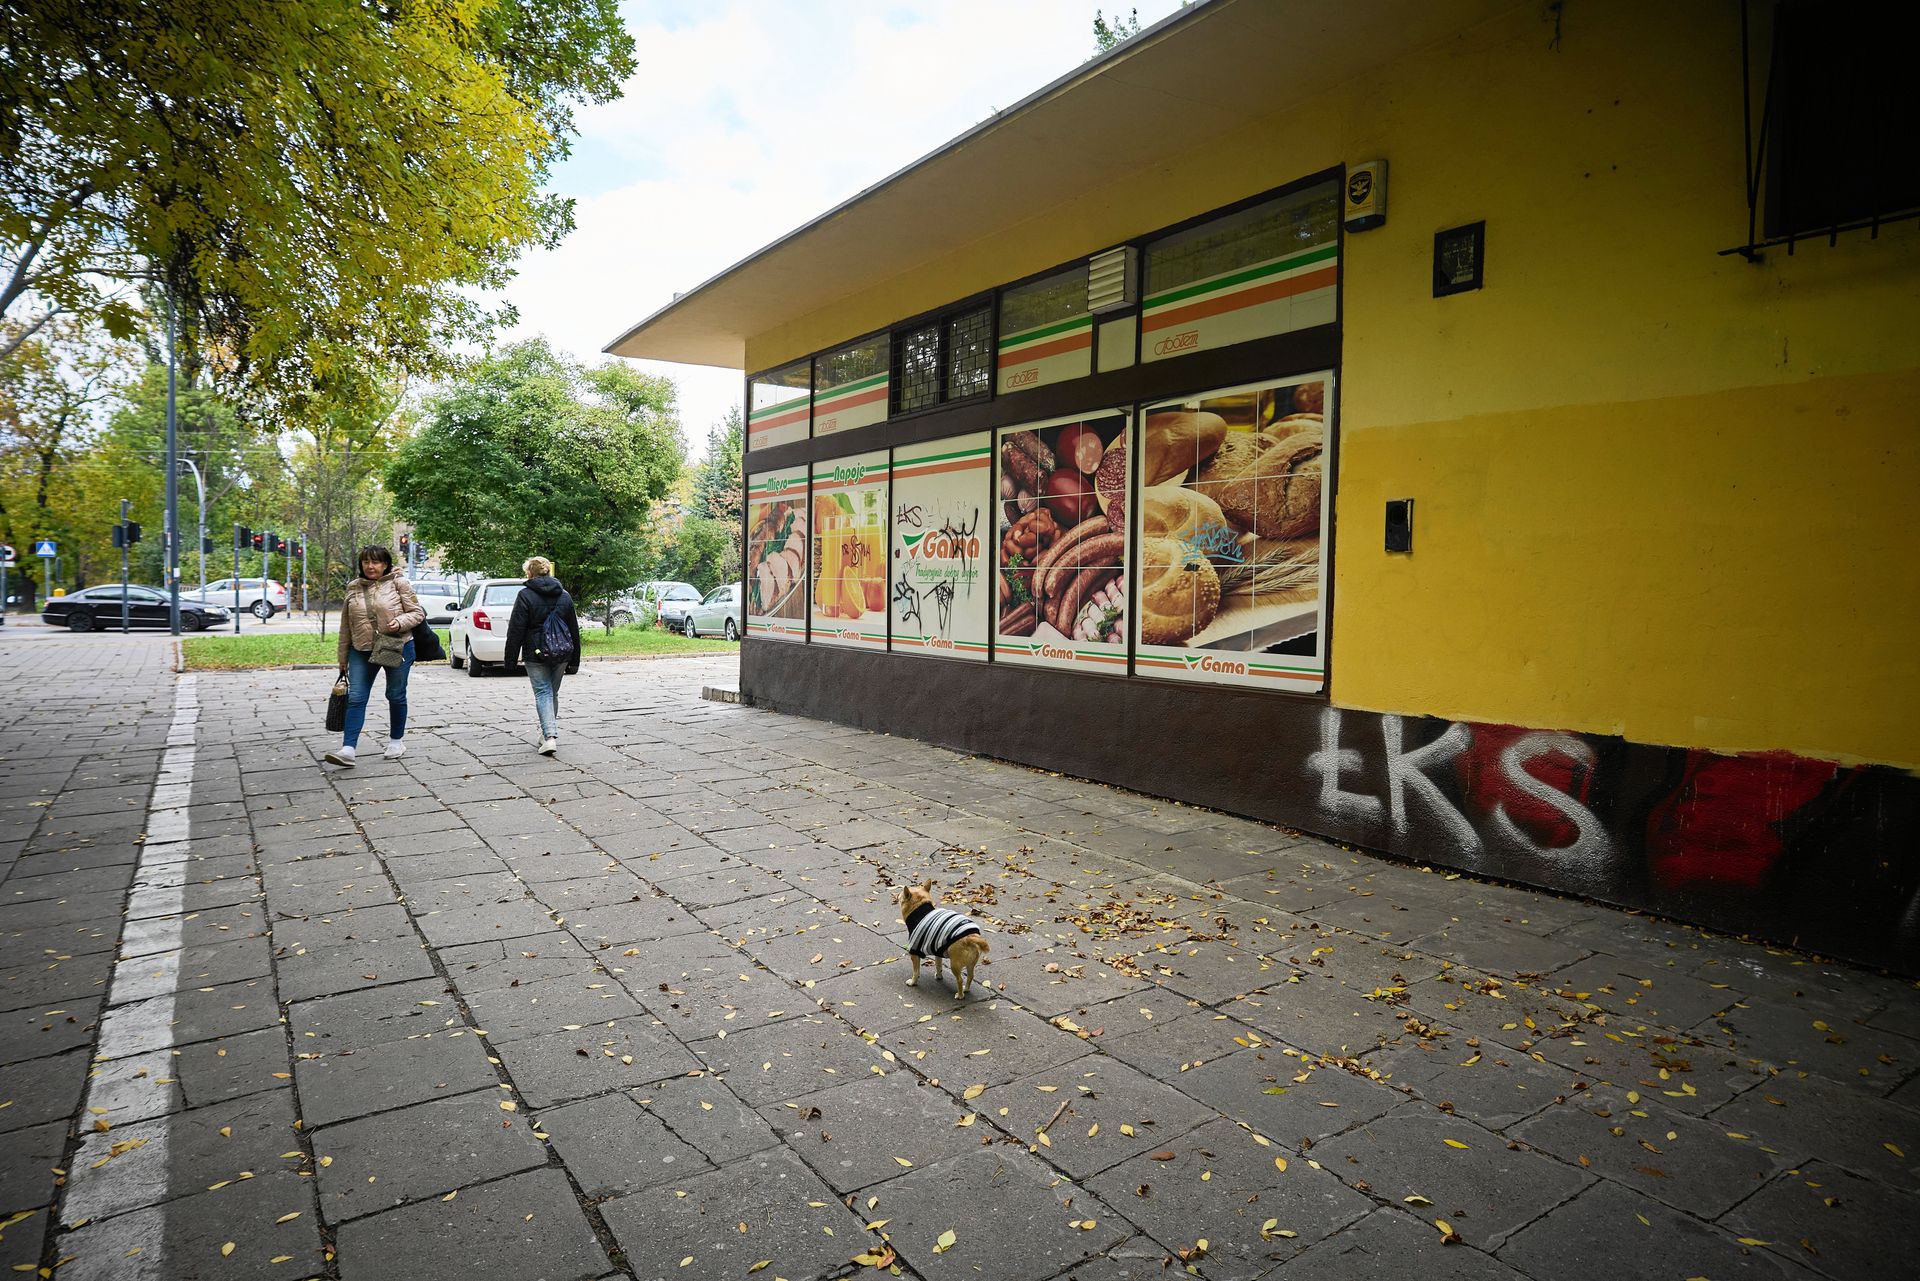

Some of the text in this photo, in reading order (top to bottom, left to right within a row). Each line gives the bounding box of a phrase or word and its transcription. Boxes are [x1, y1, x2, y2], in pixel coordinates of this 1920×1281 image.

[833, 463, 866, 485] Napoje
[767, 477, 788, 494] Mięso
[931, 635, 953, 649] Gama
[1041, 644, 1073, 660] Gama
[1201, 655, 1245, 675] Gama
[1306, 705, 1612, 872] ŁKS
